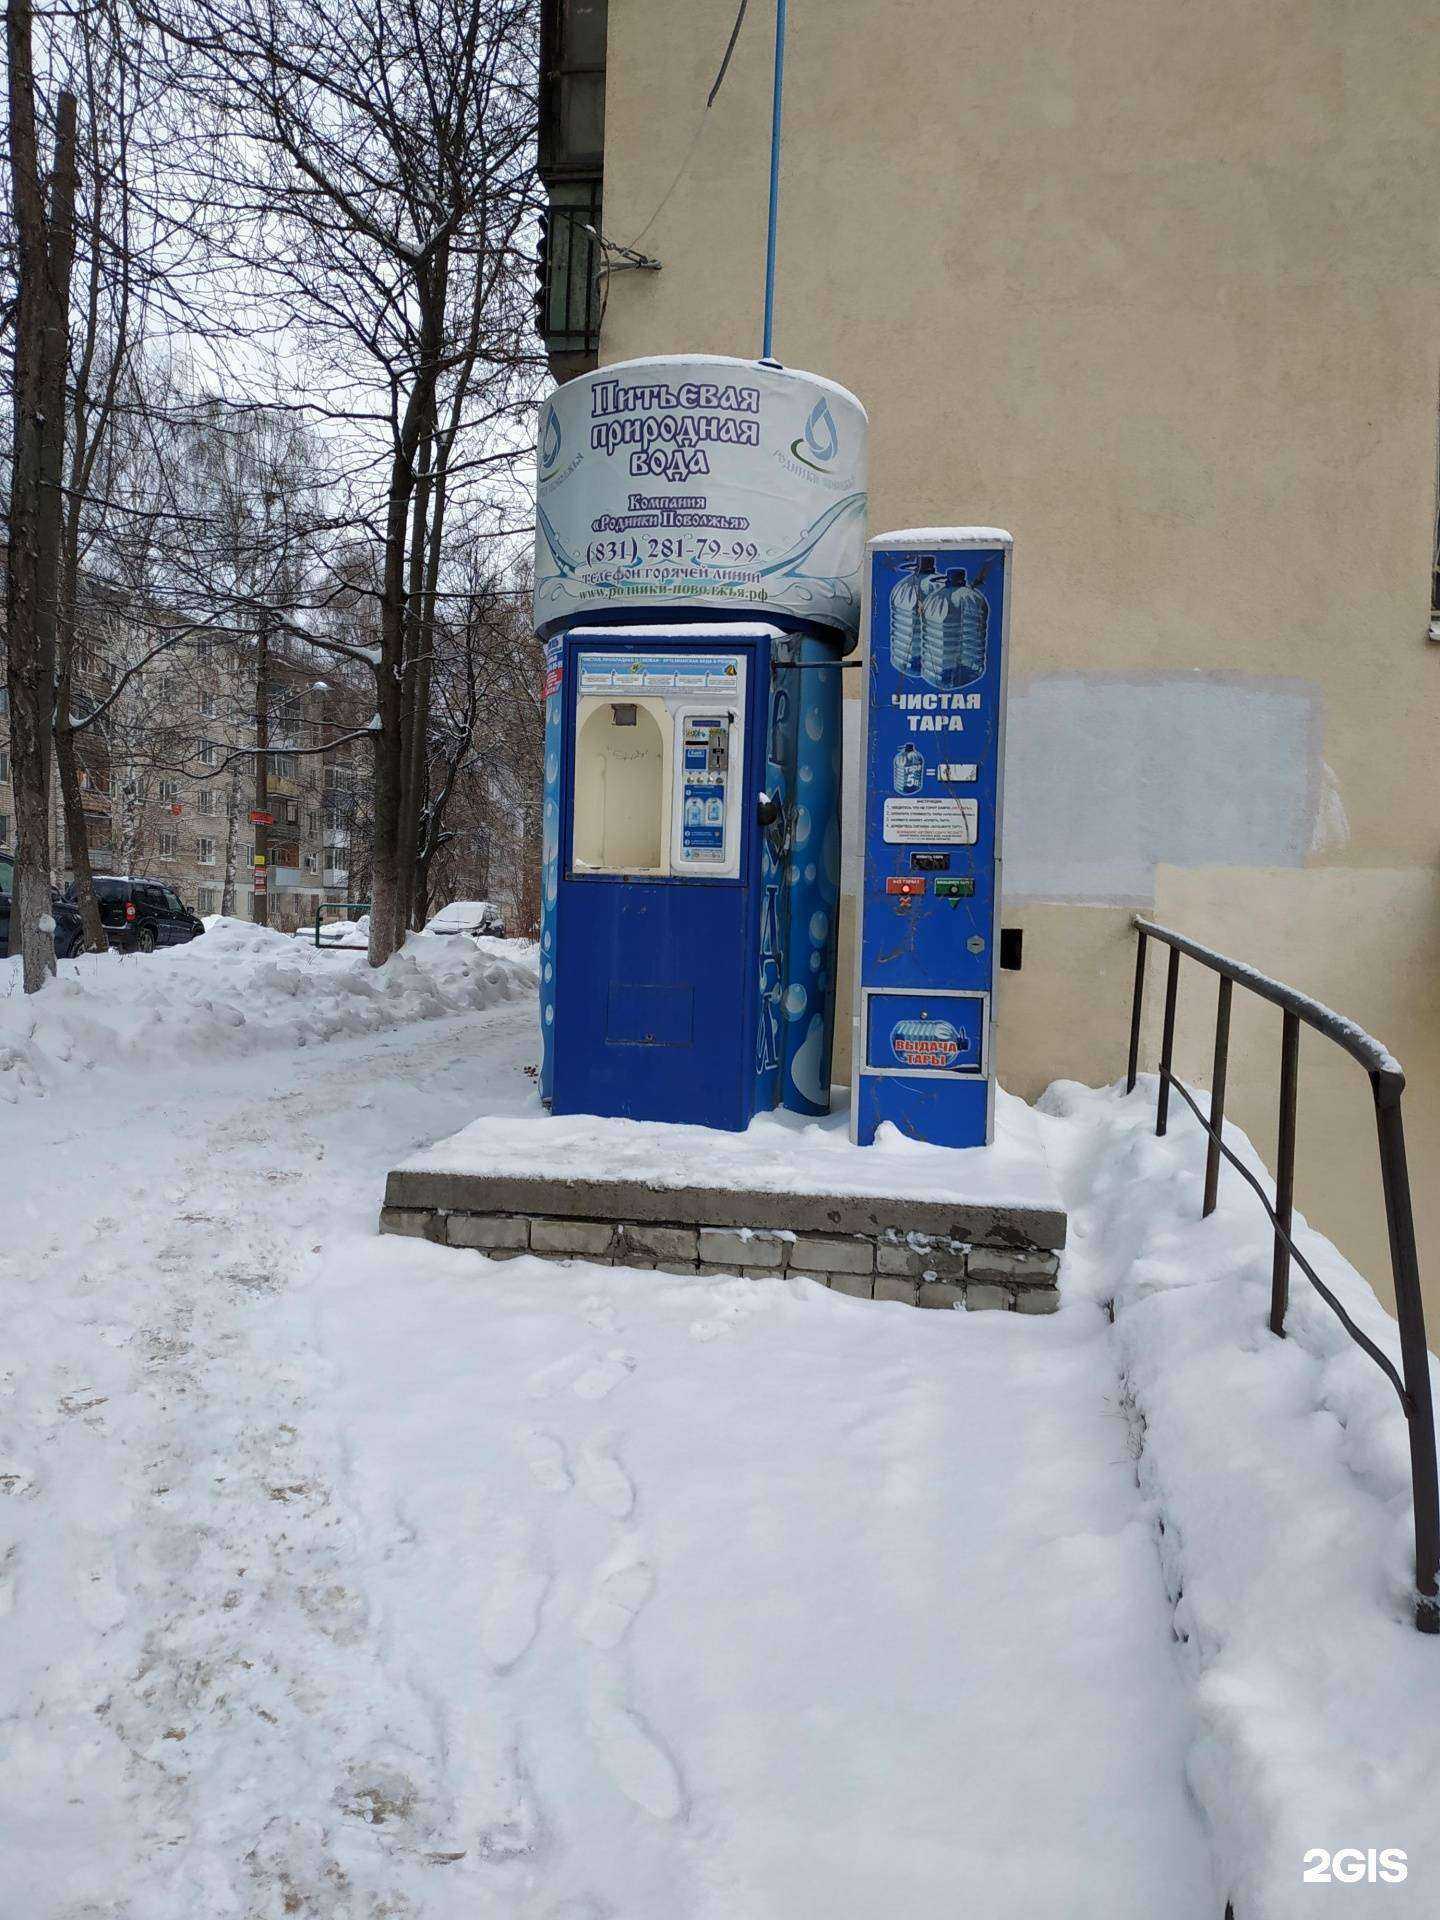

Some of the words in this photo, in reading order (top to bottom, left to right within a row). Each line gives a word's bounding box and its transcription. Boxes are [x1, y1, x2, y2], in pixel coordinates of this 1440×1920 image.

[591, 380, 760, 418] Питьевая
[591, 415, 760, 456] природная
[629, 449, 710, 482] вода
[628, 494, 706, 511] Компания
[586, 537, 638, 567] (831)
[647, 538, 758, 562] 281-79-99
[582, 566, 641, 584] телефон
[645, 565, 708, 580] горячей
[713, 571, 761, 583] линии
[892, 694, 980, 709] ЧИСТАЯ
[907, 715, 964, 731] ТАРА
[895, 1040, 957, 1053] ВЫДАЧА
[908, 1054, 946, 1066] ТАРЫ
